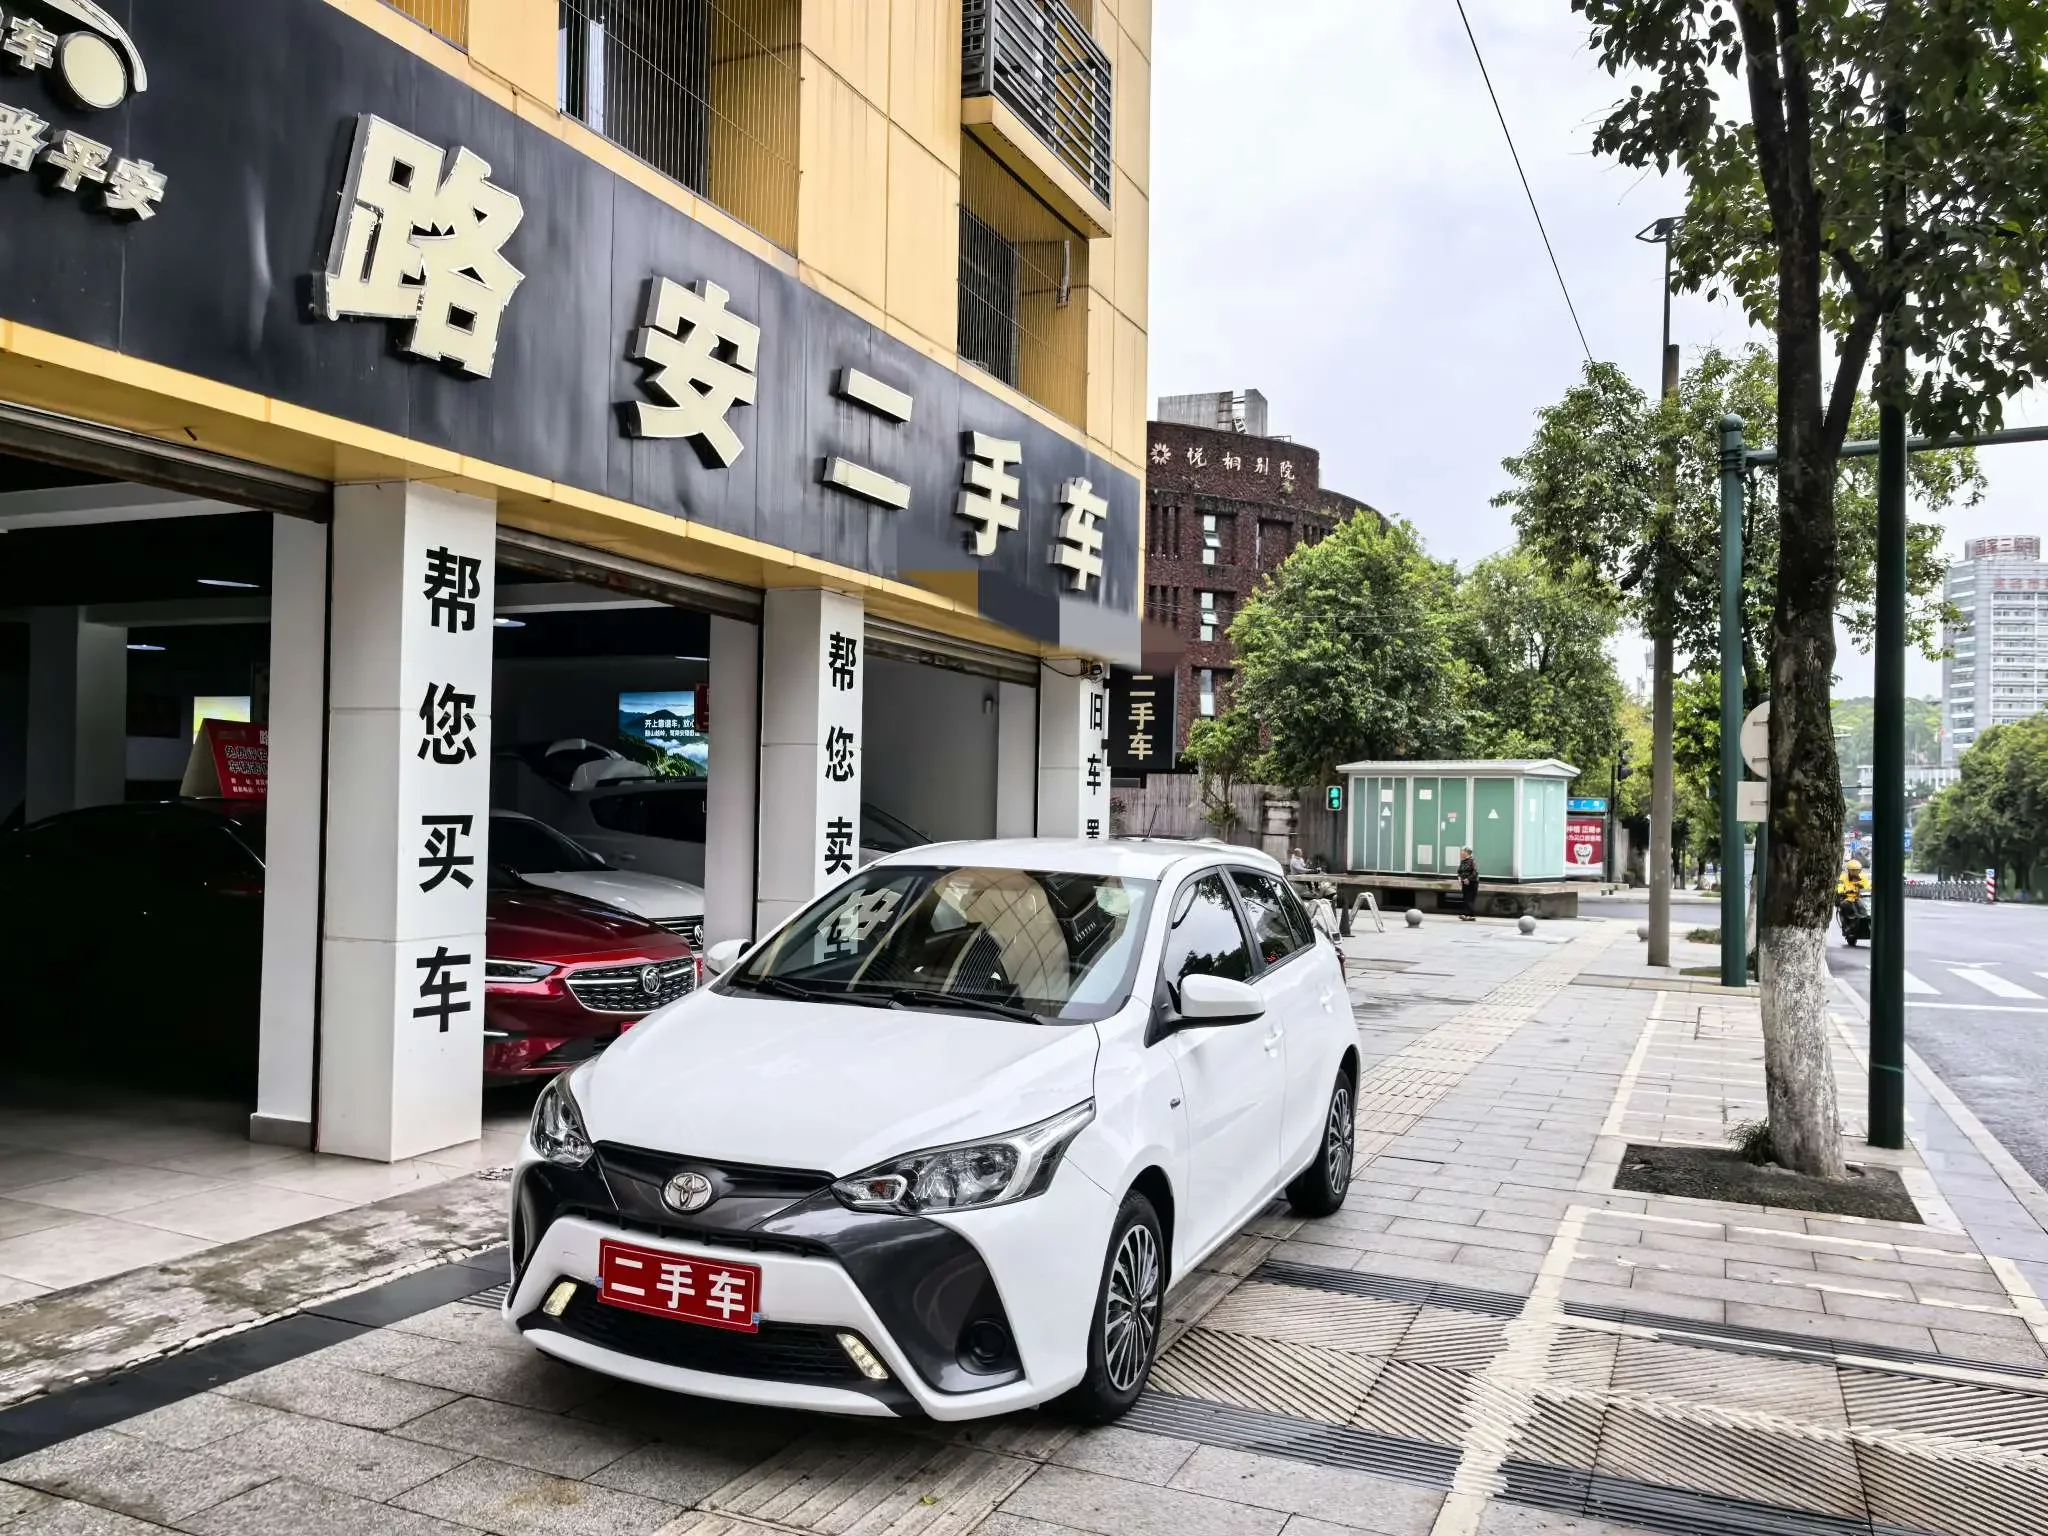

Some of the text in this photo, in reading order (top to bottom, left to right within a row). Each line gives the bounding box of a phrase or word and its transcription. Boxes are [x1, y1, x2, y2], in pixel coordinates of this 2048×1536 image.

[0, 17, 58, 71] 车
[325, 113, 1108, 591] 路安二手车
[1187, 447, 1295, 480] 悦桐别院
[1127, 675, 1156, 761] 二手车
[412, 546, 482, 1033] 帮您买车
[610, 1256, 746, 1319] 二手车
